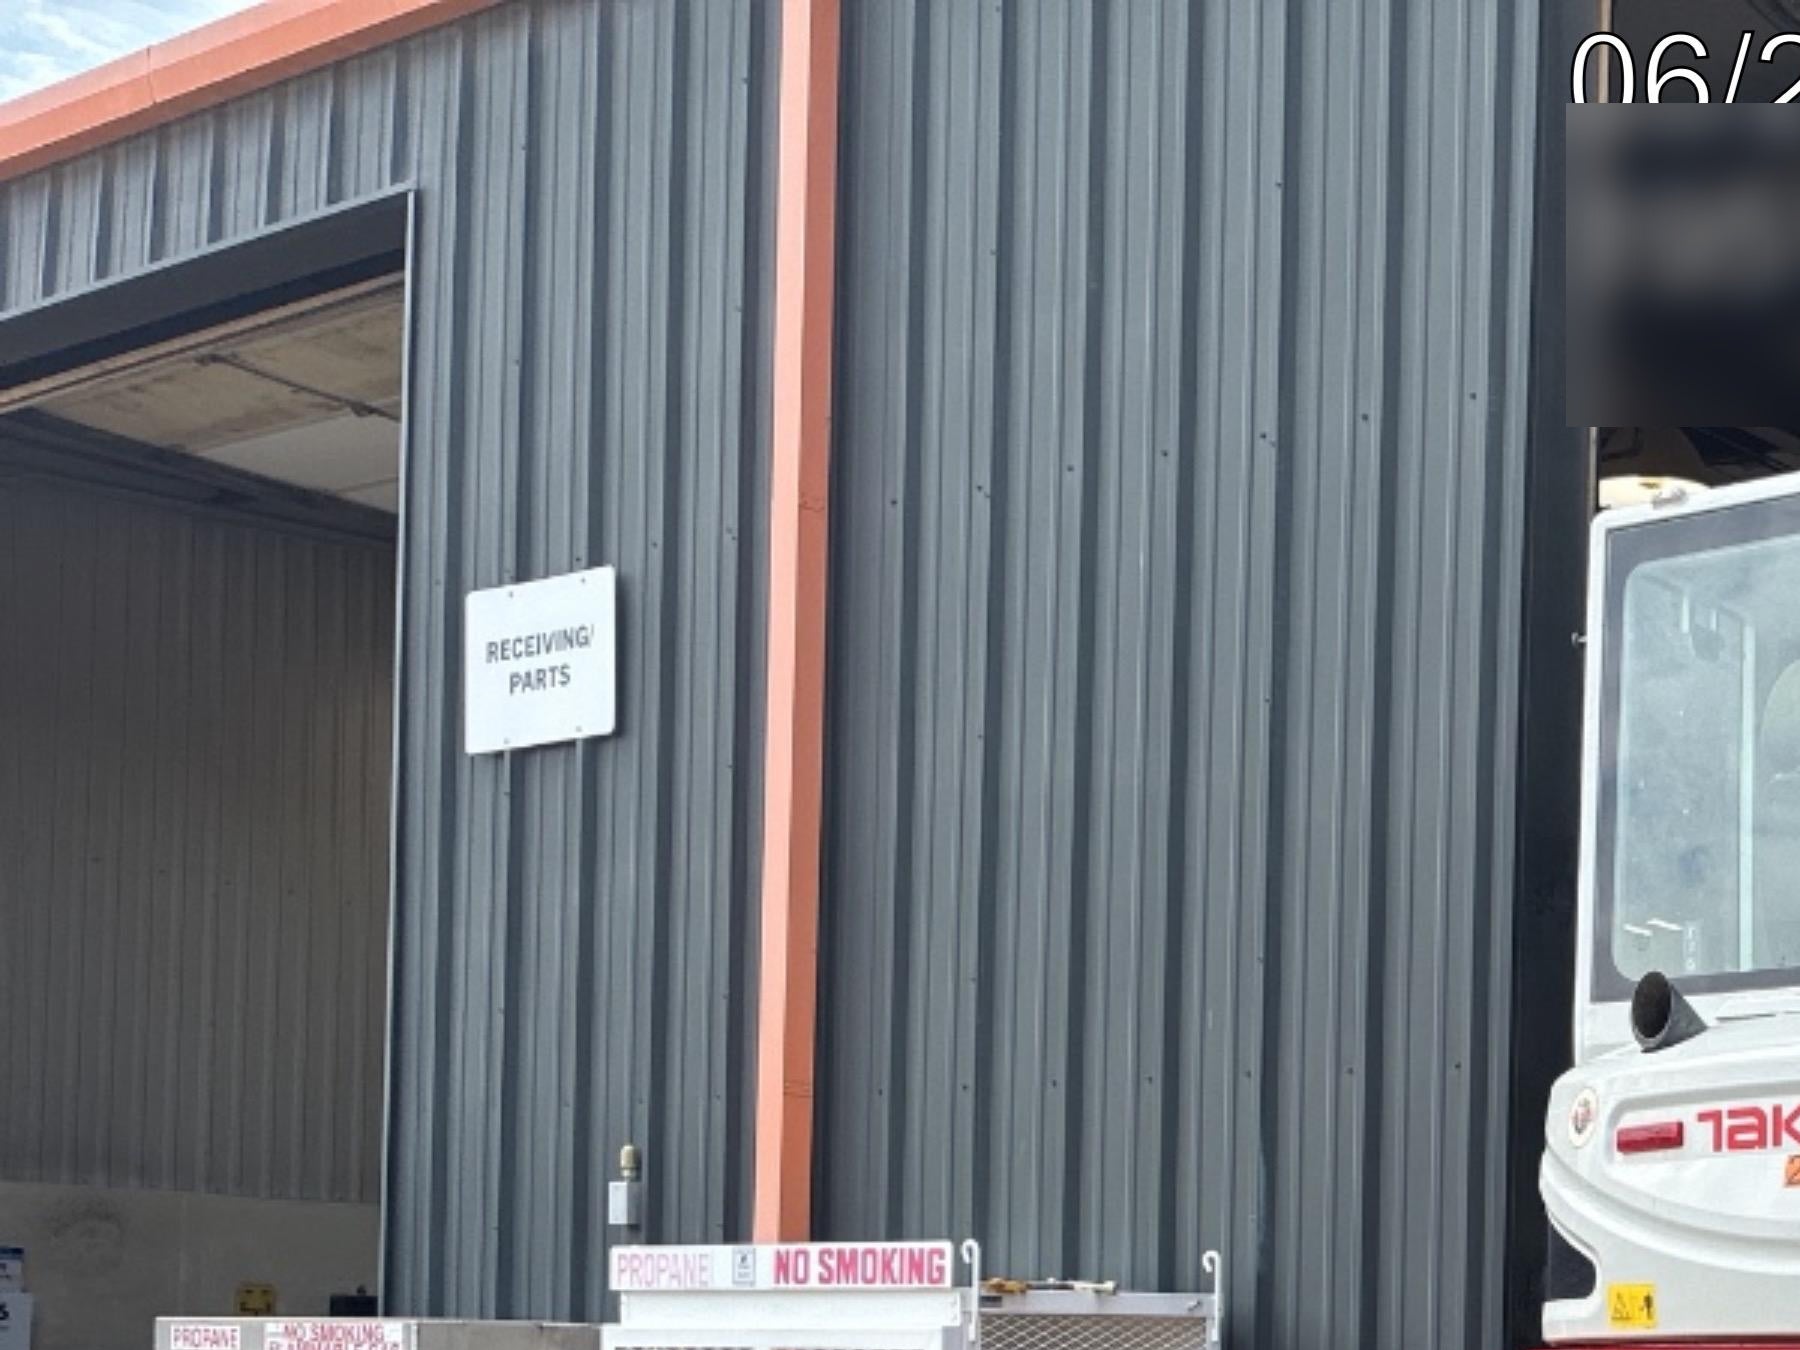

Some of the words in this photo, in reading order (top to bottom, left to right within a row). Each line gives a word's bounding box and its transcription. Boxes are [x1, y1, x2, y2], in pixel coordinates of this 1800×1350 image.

[509, 664, 571, 694] PARTS
[618, 1253, 709, 1288] PROPANE
[774, 1247, 810, 1285] NO
[818, 1247, 946, 1285] SMOKING
[174, 1328, 238, 1348] PROPANE
[284, 1324, 306, 1340] NO
[311, 1324, 384, 1342] SMOKING
